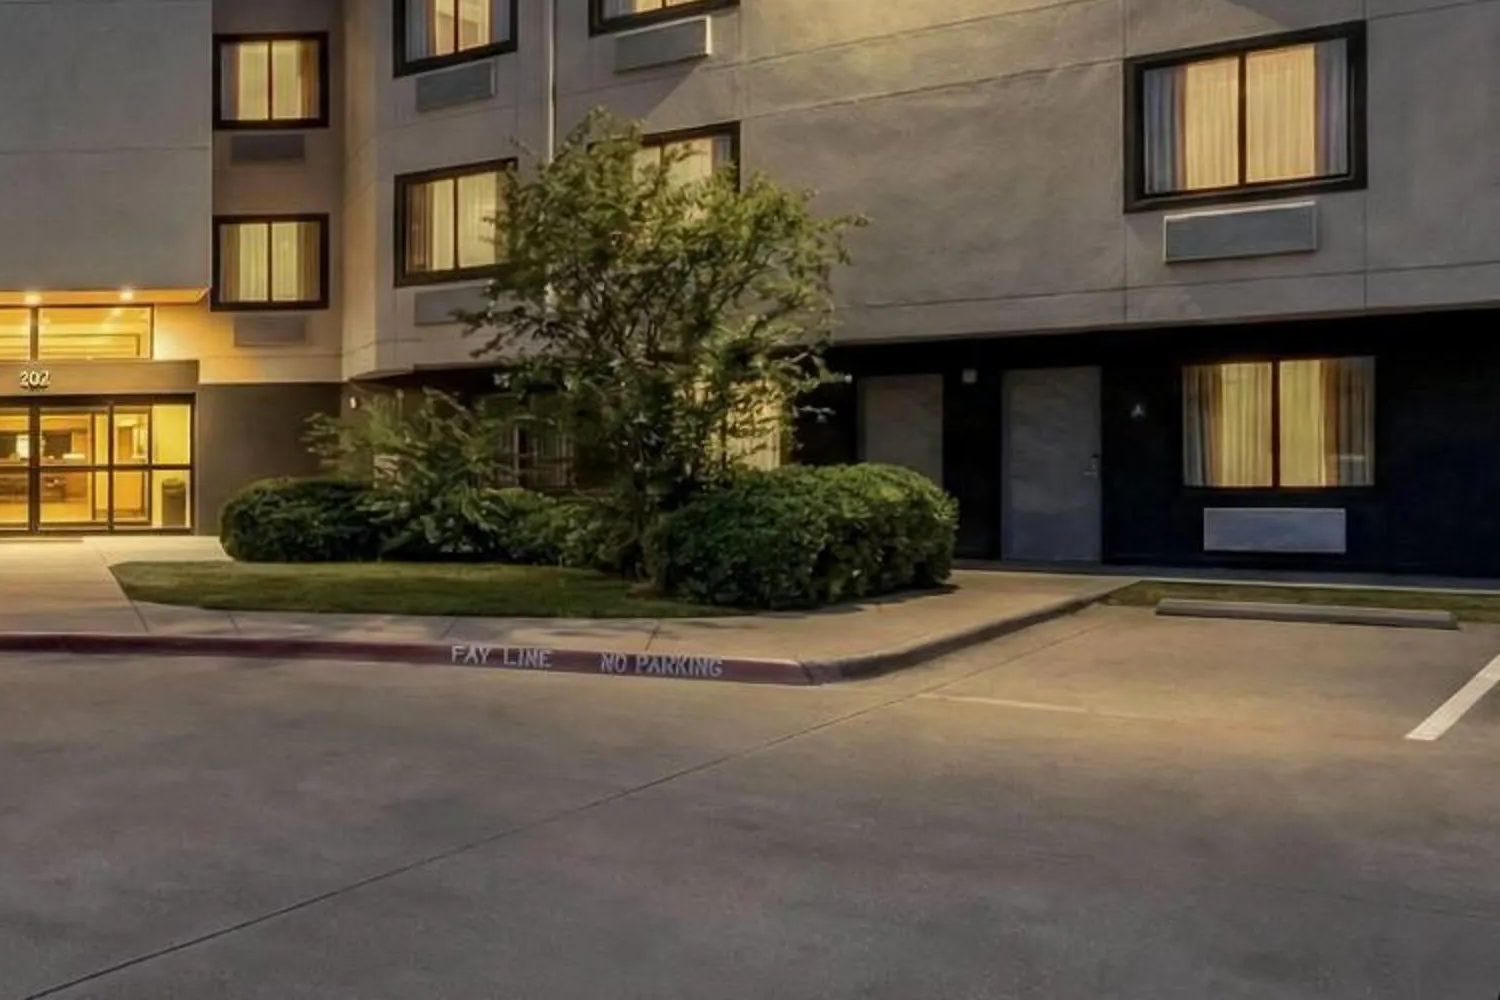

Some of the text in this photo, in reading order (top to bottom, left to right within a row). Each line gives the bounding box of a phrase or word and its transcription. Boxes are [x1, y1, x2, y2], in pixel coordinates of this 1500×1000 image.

[19, 370, 50, 387] 202
[600, 652, 724, 678] NO PARKING
